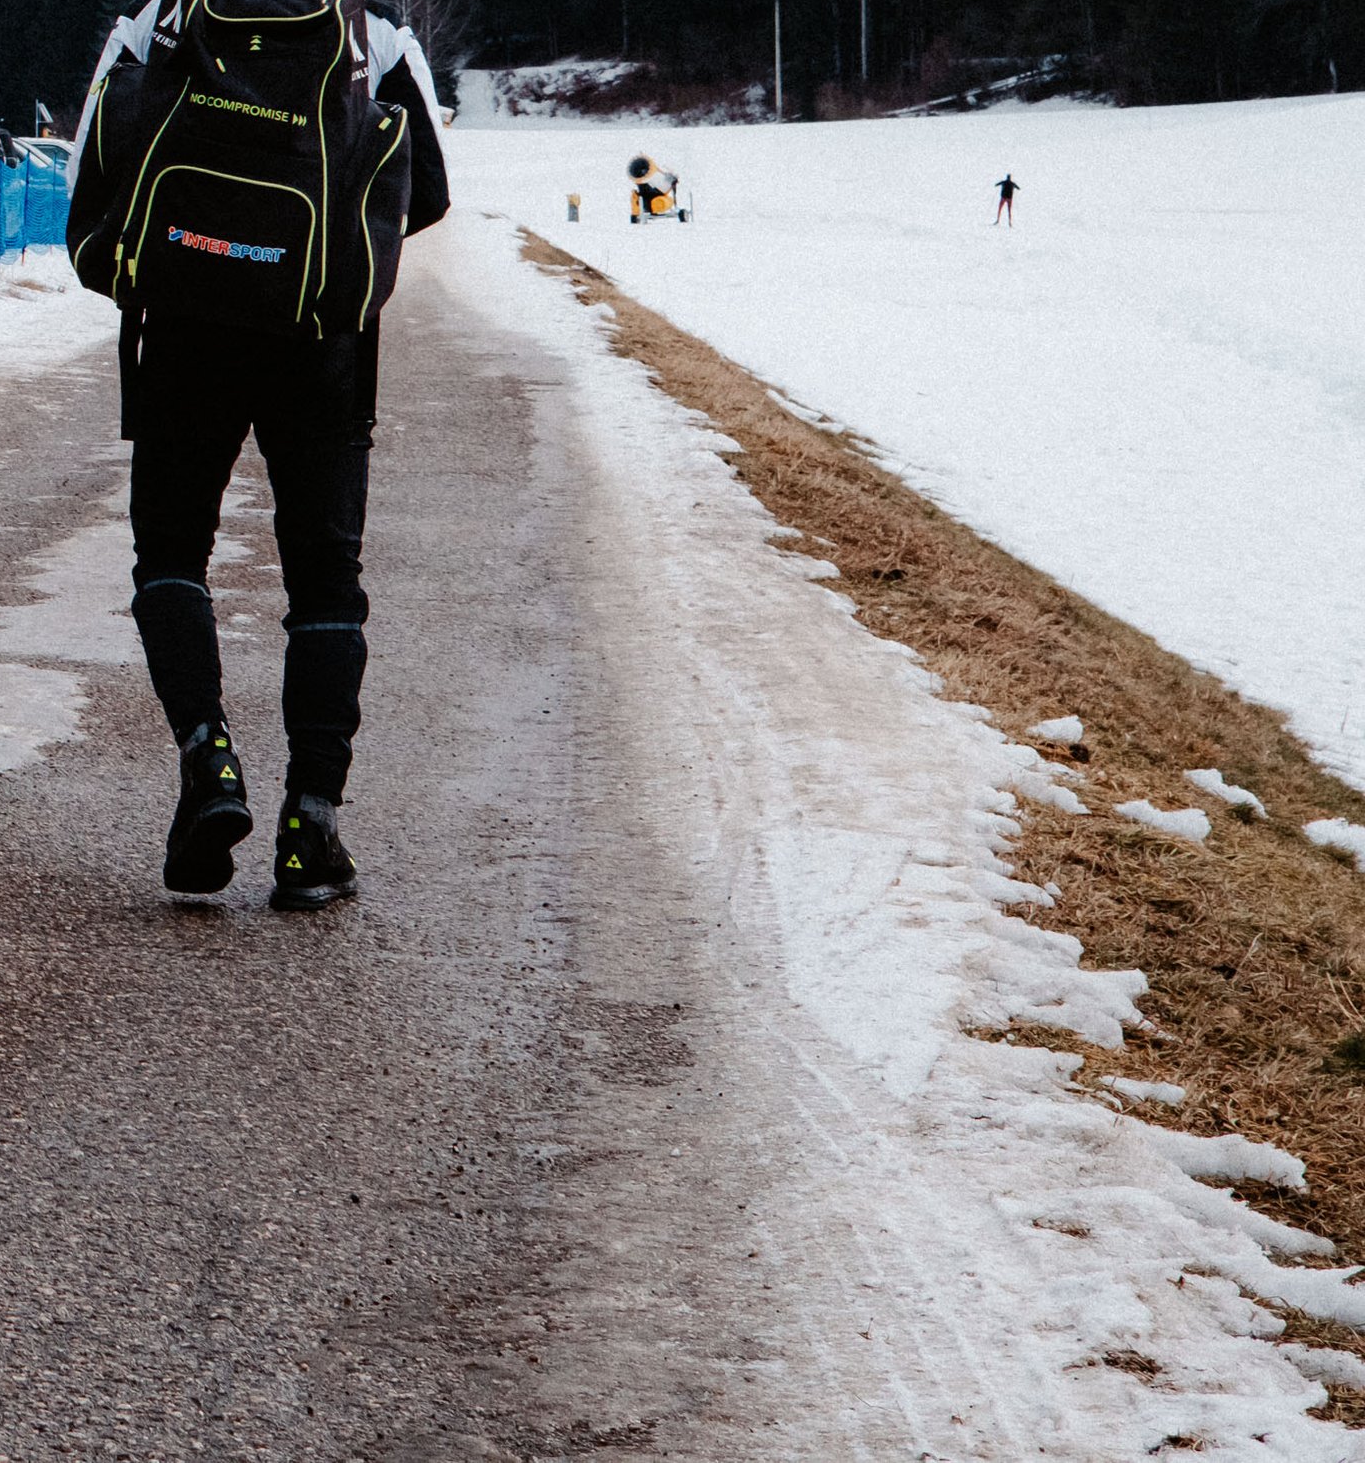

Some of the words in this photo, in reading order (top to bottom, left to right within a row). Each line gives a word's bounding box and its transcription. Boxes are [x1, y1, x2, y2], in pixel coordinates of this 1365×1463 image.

[190, 92, 207, 105] NO
[206, 95, 290, 123] COMPROMISE
[181, 231, 287, 263] INTERSPORT
